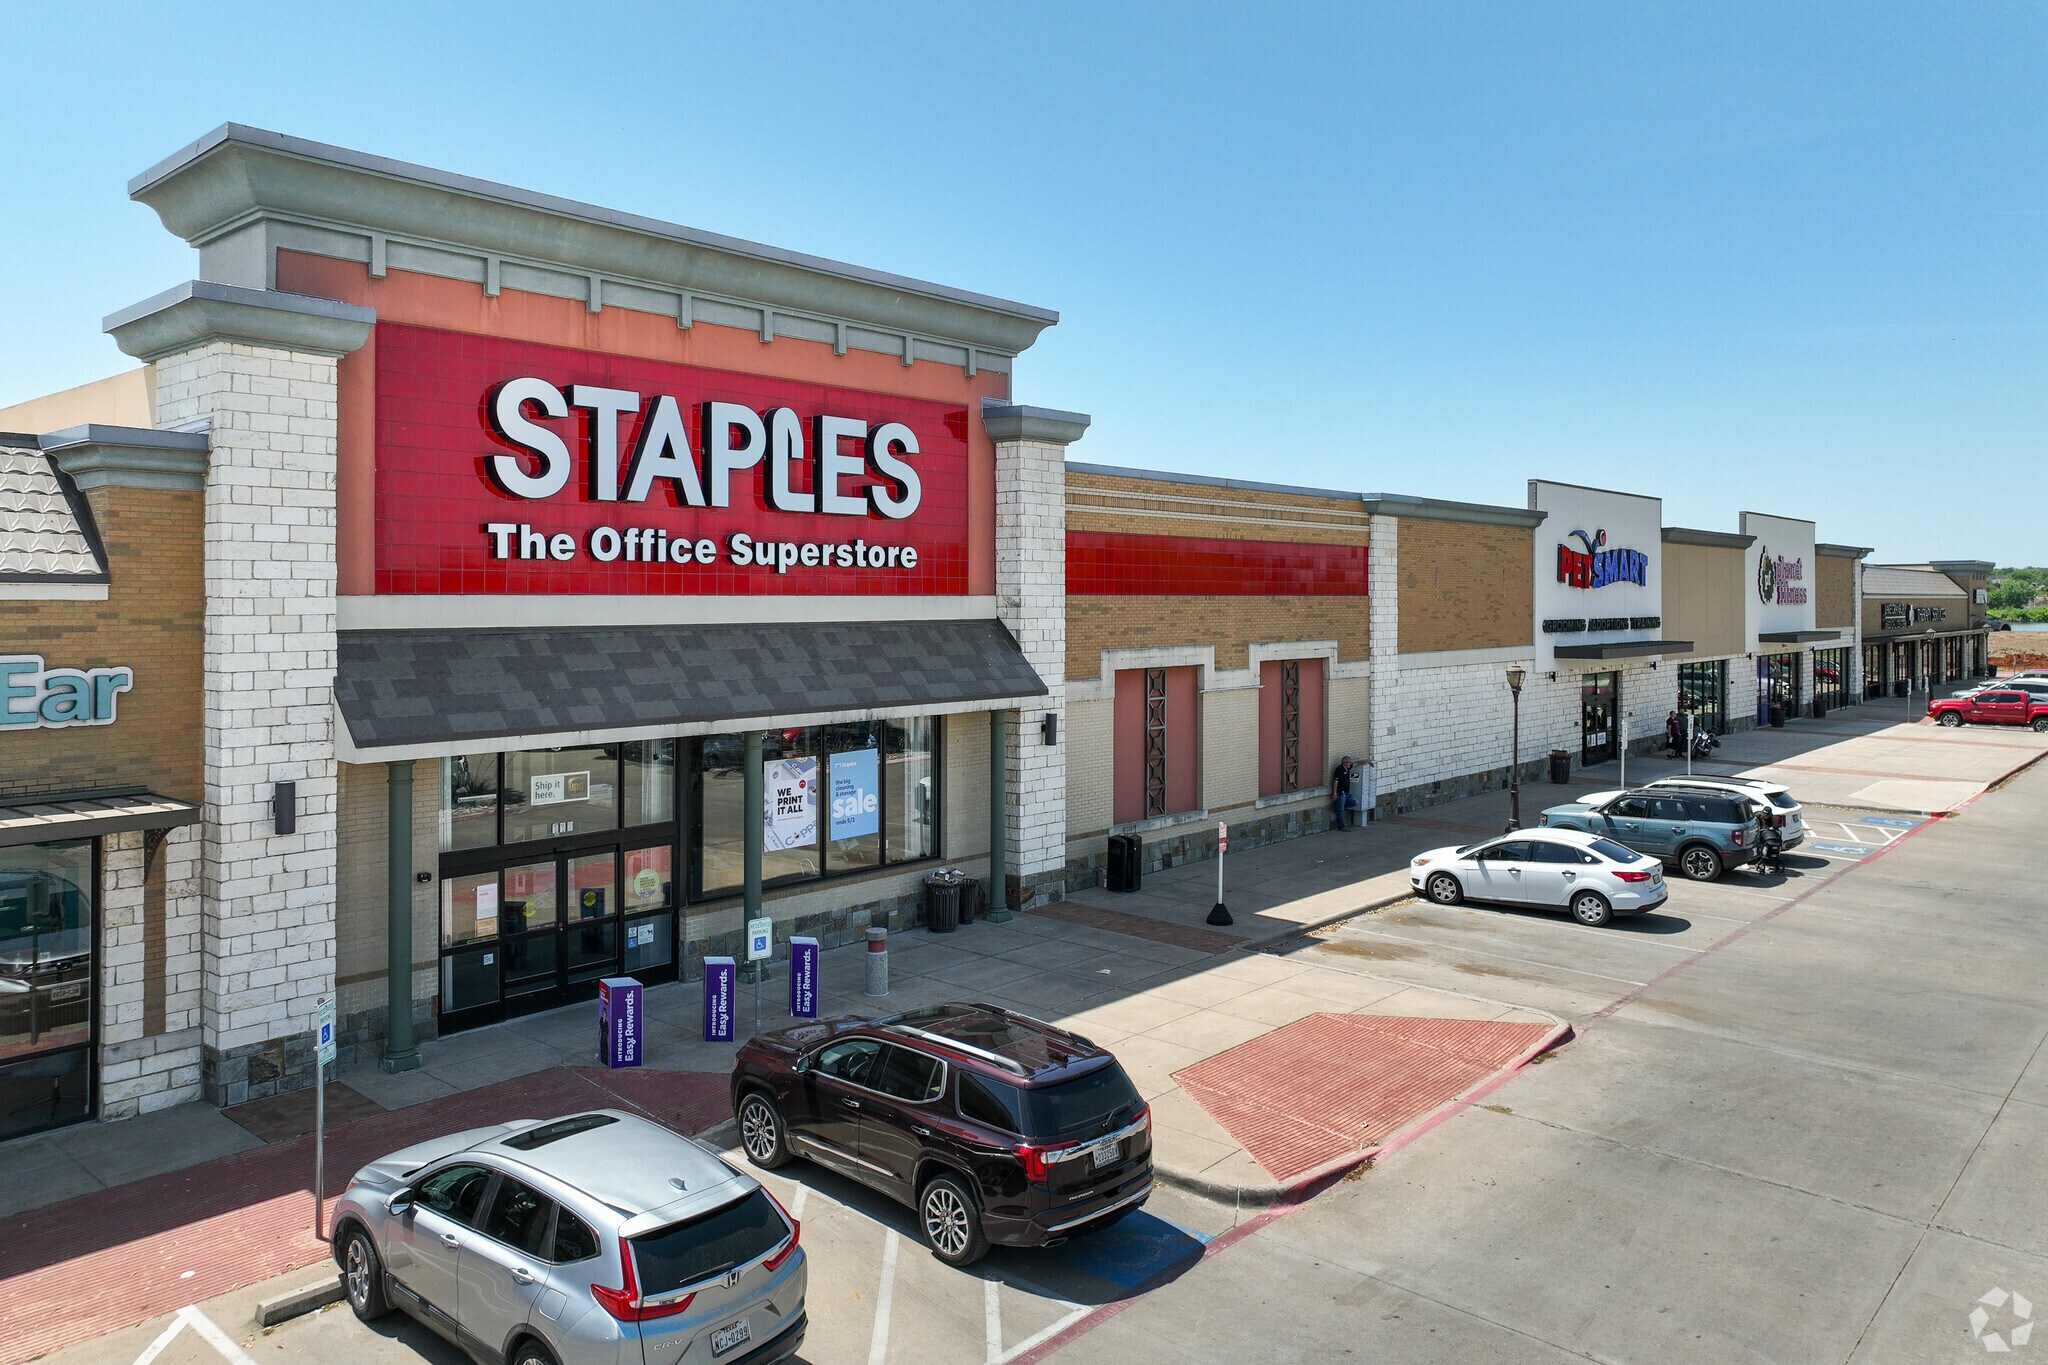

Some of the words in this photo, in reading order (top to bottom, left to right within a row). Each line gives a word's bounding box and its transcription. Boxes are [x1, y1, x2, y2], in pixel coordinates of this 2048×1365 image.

[490, 376, 922, 519] STAPLES
[486, 523, 576, 561] The
[588, 526, 716, 564] Office
[729, 533, 918, 574] Superstore
[1543, 619, 1586, 633] GROOMING
[1588, 618, 1629, 631] ADOPTIONS
[0, 661, 129, 724] Ear
[535, 781, 553, 790] Ship
[835, 784, 854, 792] cleaning
[535, 791, 555, 799] here.
[777, 788, 791, 797] WE
[777, 795, 803, 807] PRINT
[832, 788, 877, 819] sale
[777, 807, 786, 815] IT
[787, 804, 803, 815] ALL
[847, 817, 855, 825] 5/3
[803, 991, 812, 1012] Easy
[718, 1013, 729, 1037] Easy
[624, 1039, 637, 1062] Easy
[723, 1324, 738, 1333] TEXAS
[653, 1338, 682, 1350] CR-V
